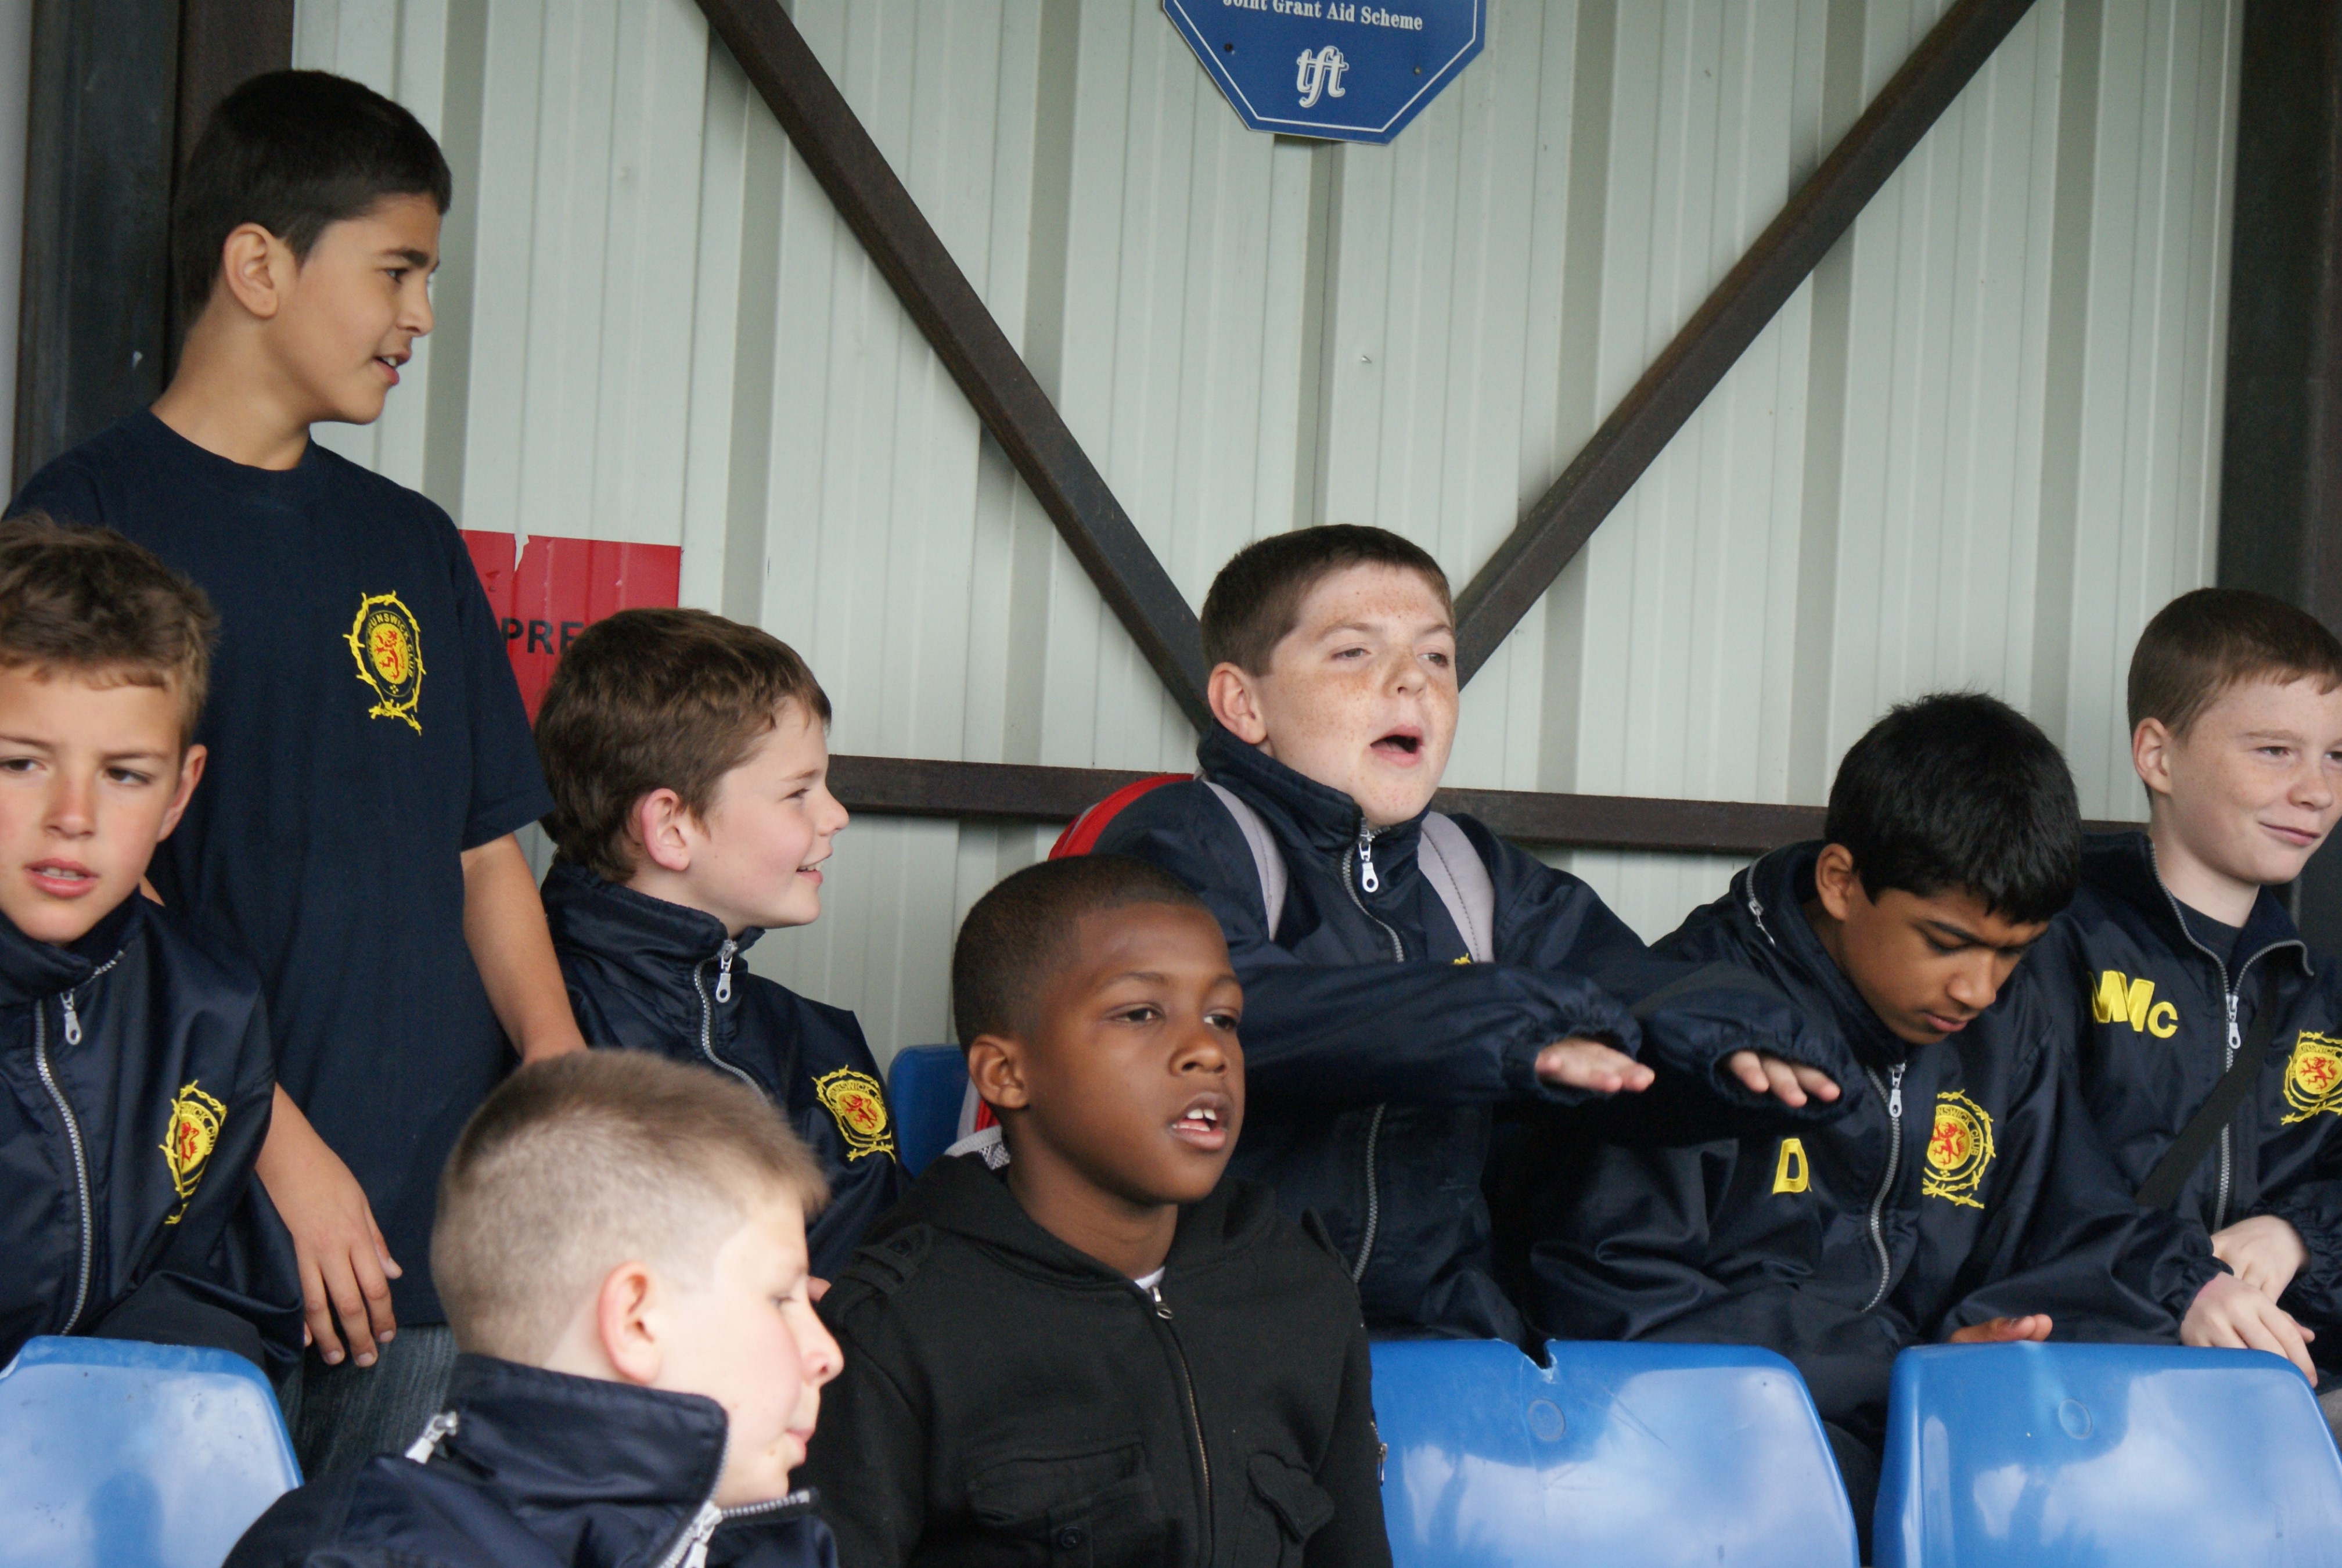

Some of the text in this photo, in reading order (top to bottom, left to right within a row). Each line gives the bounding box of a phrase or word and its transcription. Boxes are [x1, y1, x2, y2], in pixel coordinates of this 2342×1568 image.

[1273, 0, 1322, 18] Grant
[1327, 2, 1355, 22] Aid
[1361, 6, 1423, 30] Scheme
[501, 617, 584, 655] PRE
[1970, 1129, 1980, 1156] CLUB
